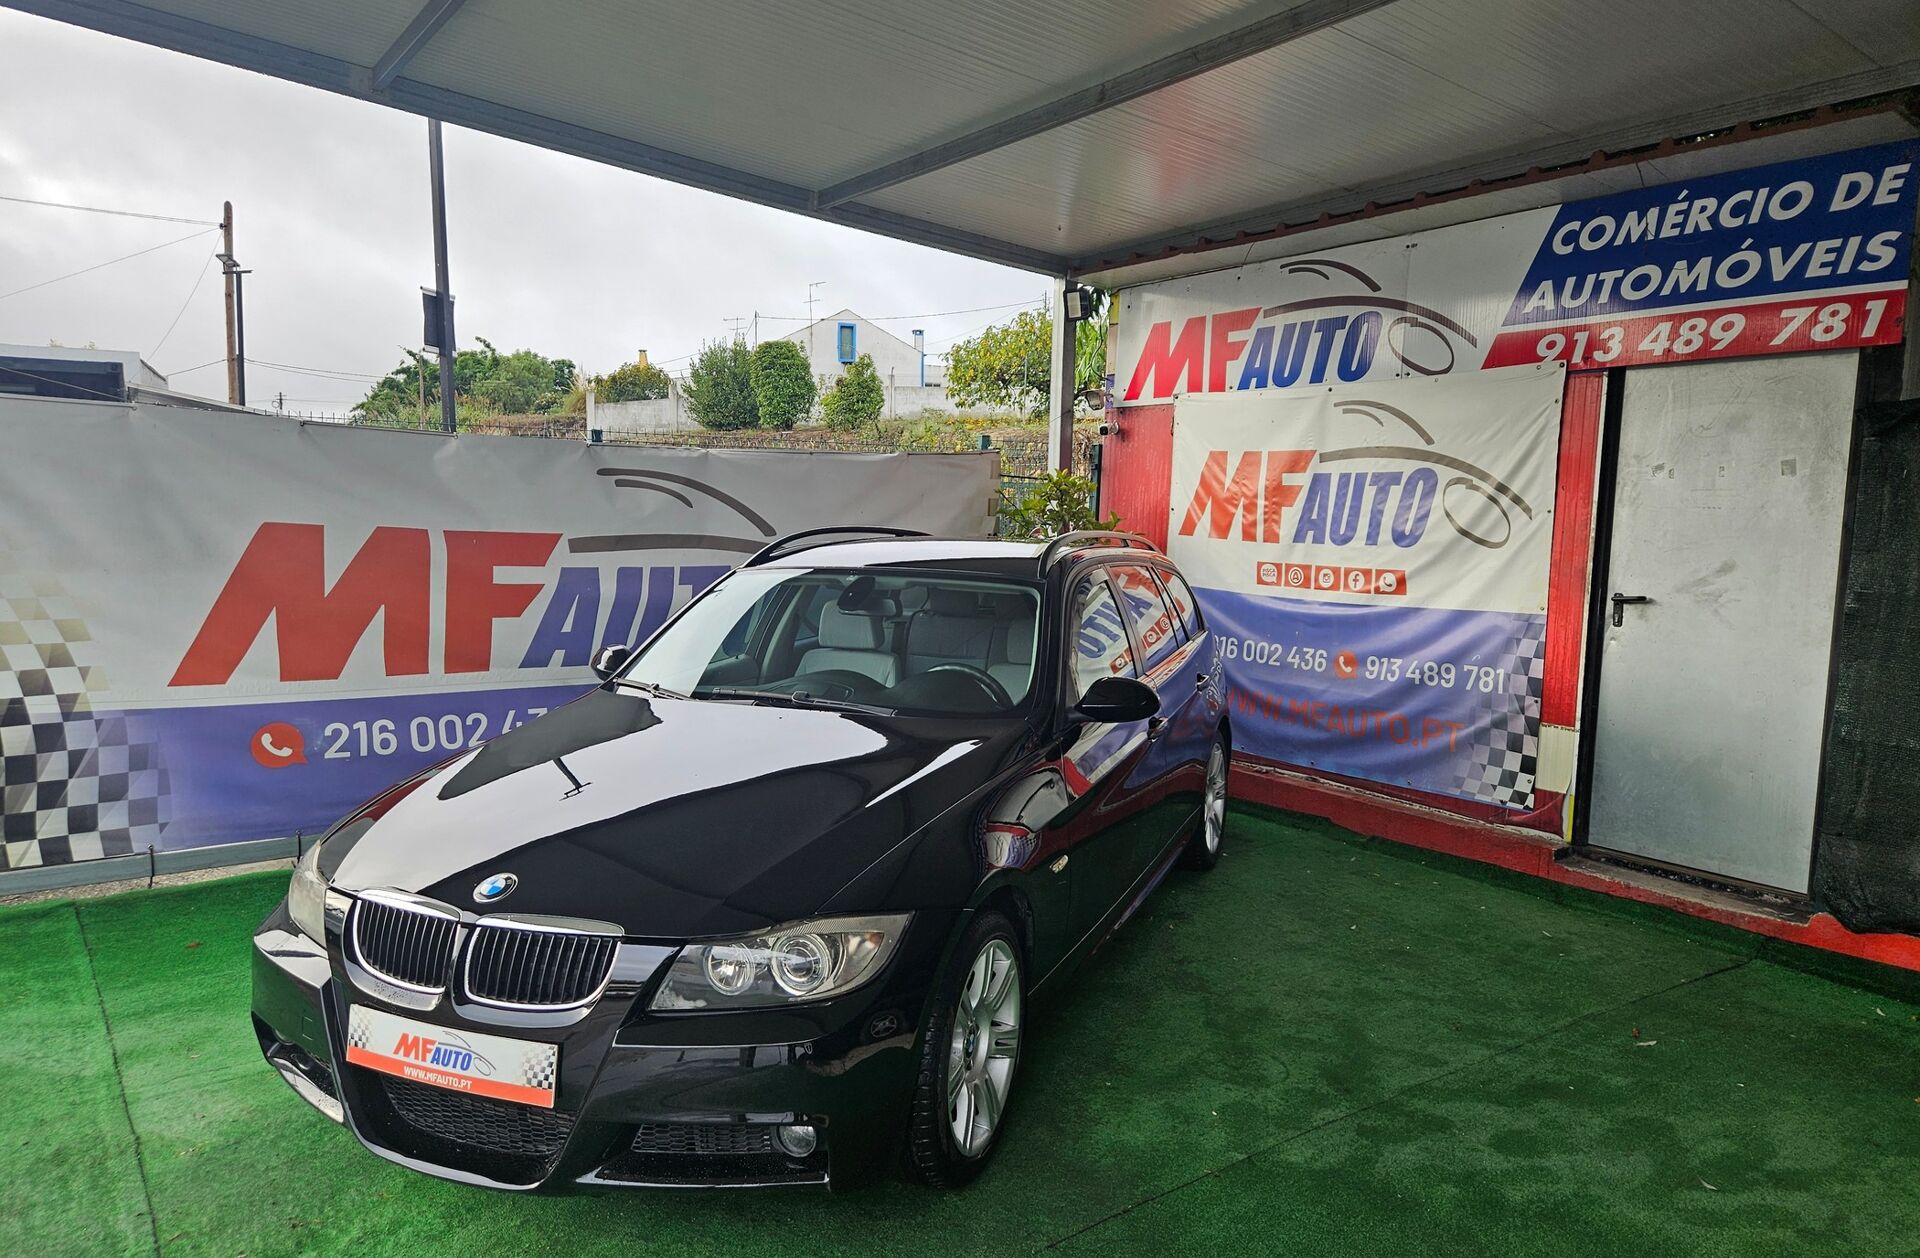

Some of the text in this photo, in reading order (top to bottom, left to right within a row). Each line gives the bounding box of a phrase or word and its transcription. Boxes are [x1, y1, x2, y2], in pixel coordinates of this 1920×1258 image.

[1552, 162, 1912, 256] COMÉRCIO DE
[1522, 230, 1903, 314] AUTOMÓVEIS
[1536, 299, 1888, 364] 913 489 781
[1217, 636, 1505, 694] 16 002 436 913 489 781
[323, 718, 398, 760] 216
[409, 711, 489, 753] 002
[403, 1065, 473, 1091] WWW.MFAUTO.PT
